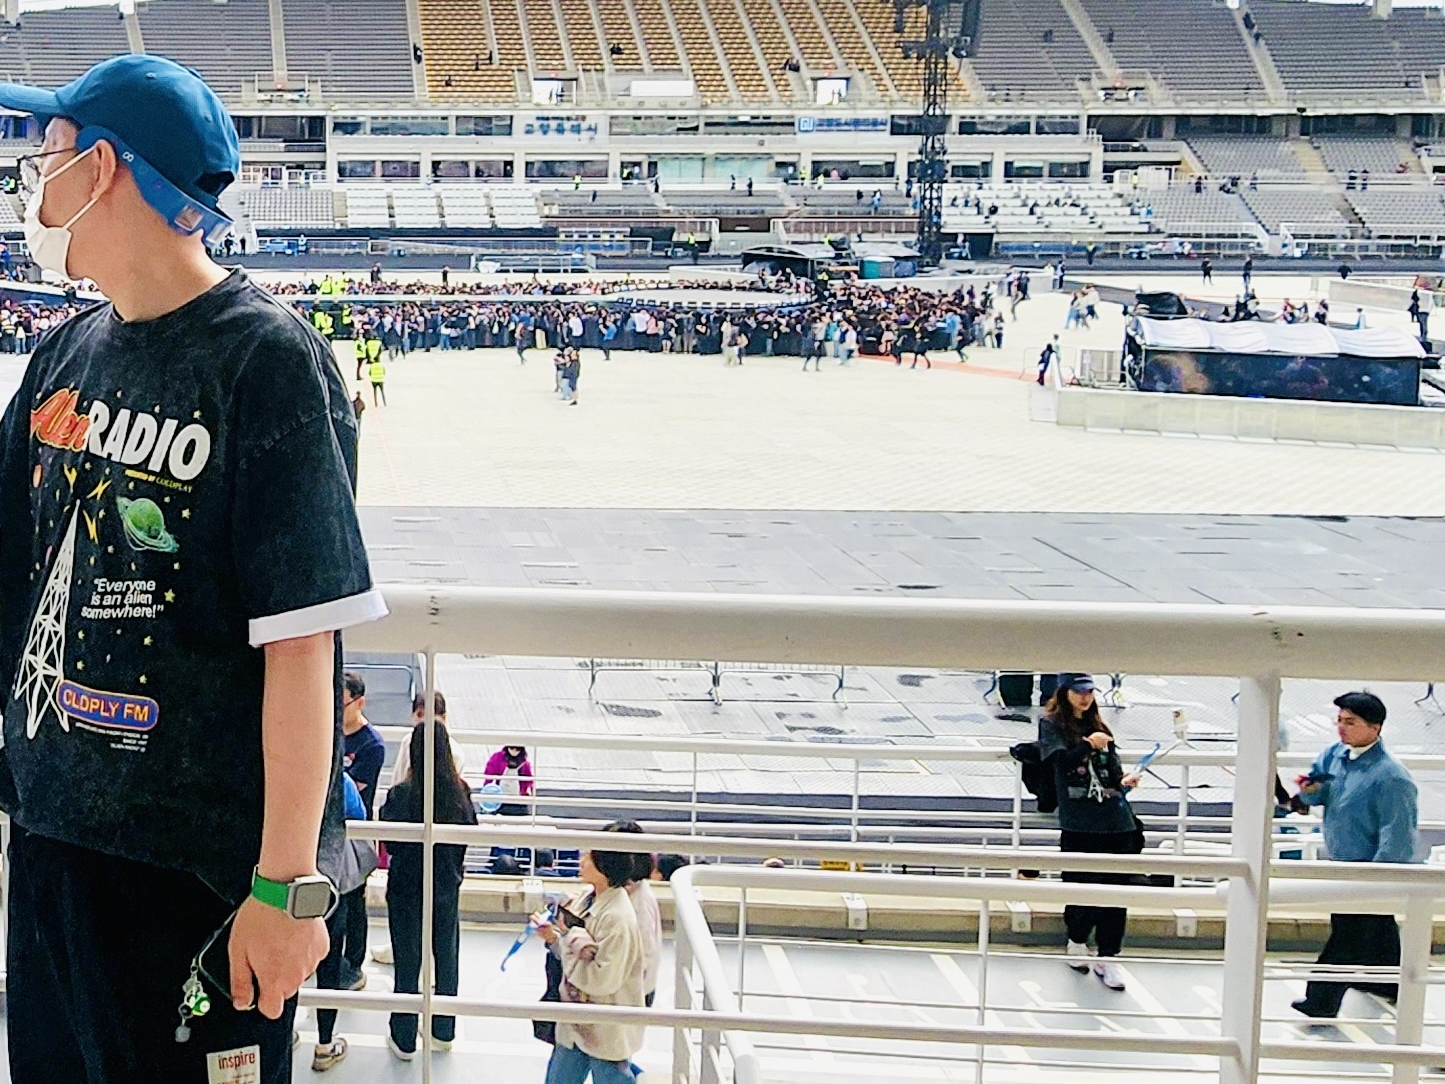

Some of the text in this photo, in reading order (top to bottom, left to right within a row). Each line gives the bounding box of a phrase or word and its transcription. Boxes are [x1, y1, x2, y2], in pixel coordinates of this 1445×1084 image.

[86, 400, 211, 481] RADIO
[91, 591, 152, 605] is an alien
[63, 689, 149, 721] CLDPLY FM
[218, 1052, 255, 1069] inspire
